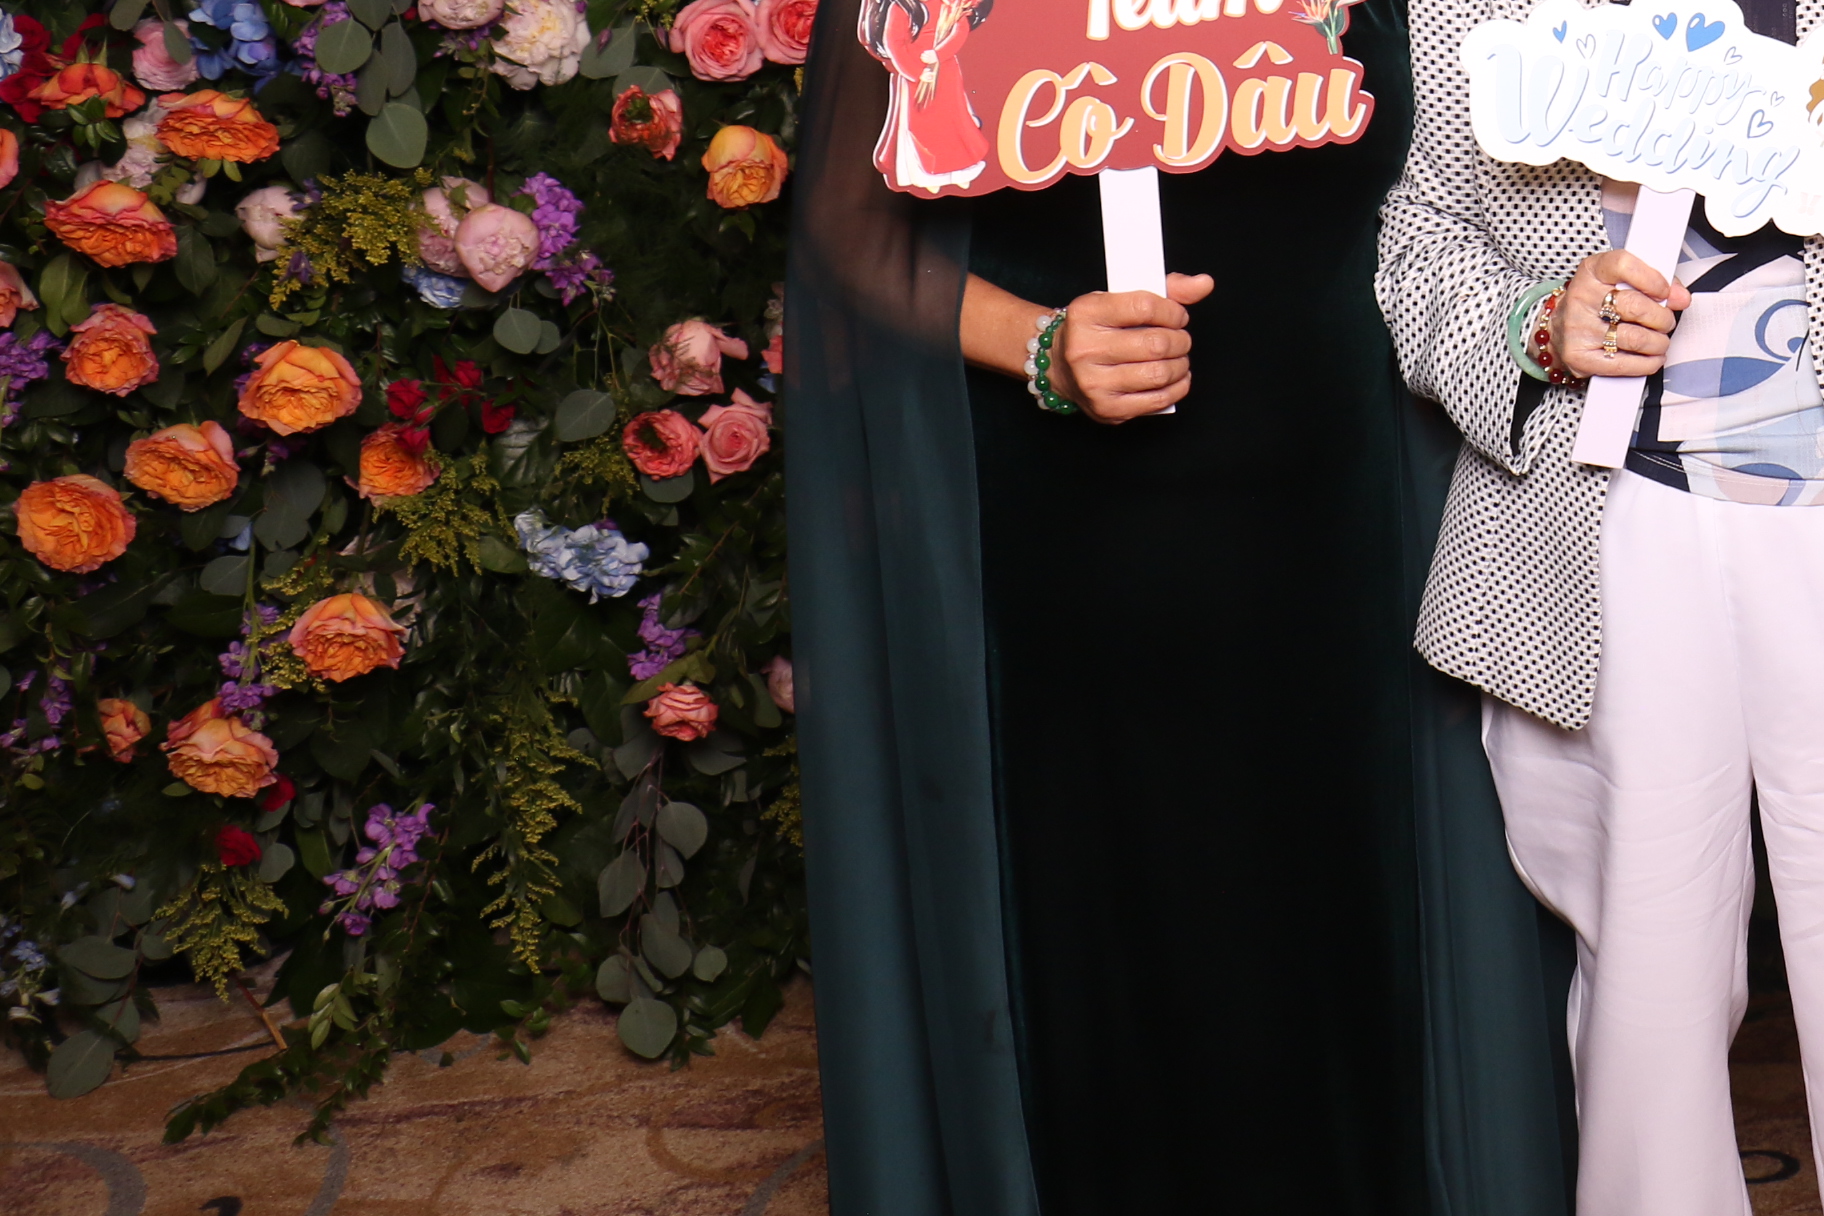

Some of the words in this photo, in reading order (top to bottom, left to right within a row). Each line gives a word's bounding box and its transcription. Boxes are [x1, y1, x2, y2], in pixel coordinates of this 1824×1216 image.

[997, 61, 1134, 184] Cô
[1140, 41, 1368, 166] Dâu
[1487, 43, 1801, 218] Wedding
[1594, 28, 1768, 123] Happy
